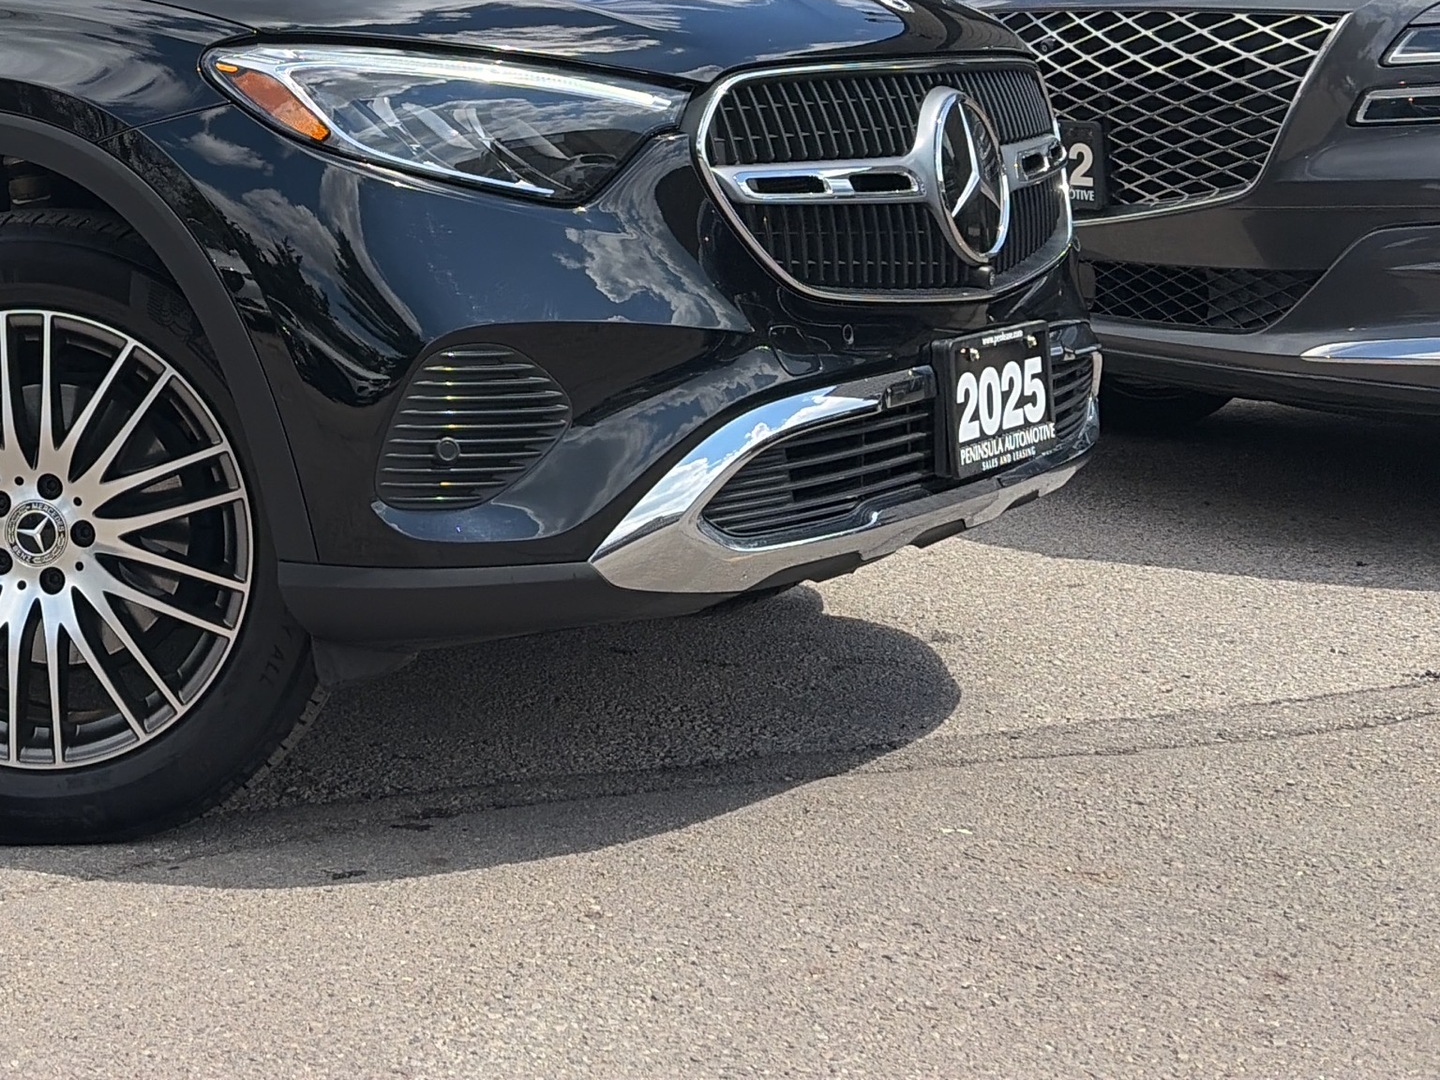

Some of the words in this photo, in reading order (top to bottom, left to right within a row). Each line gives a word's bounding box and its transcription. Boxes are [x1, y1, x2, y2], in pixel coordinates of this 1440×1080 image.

[1068, 142, 1094, 188] 2
[1069, 189, 1095, 202] OTIVE
[956, 356, 1047, 443] 2025
[960, 437, 1004, 466] PENINSULA
[1004, 422, 1056, 452] AUTOMOTIVE
[982, 458, 998, 471] SALES
[1013, 446, 1036, 461] LEASING
[31, 502, 65, 532] MERCEDES
[11, 544, 33, 563] BENZ
